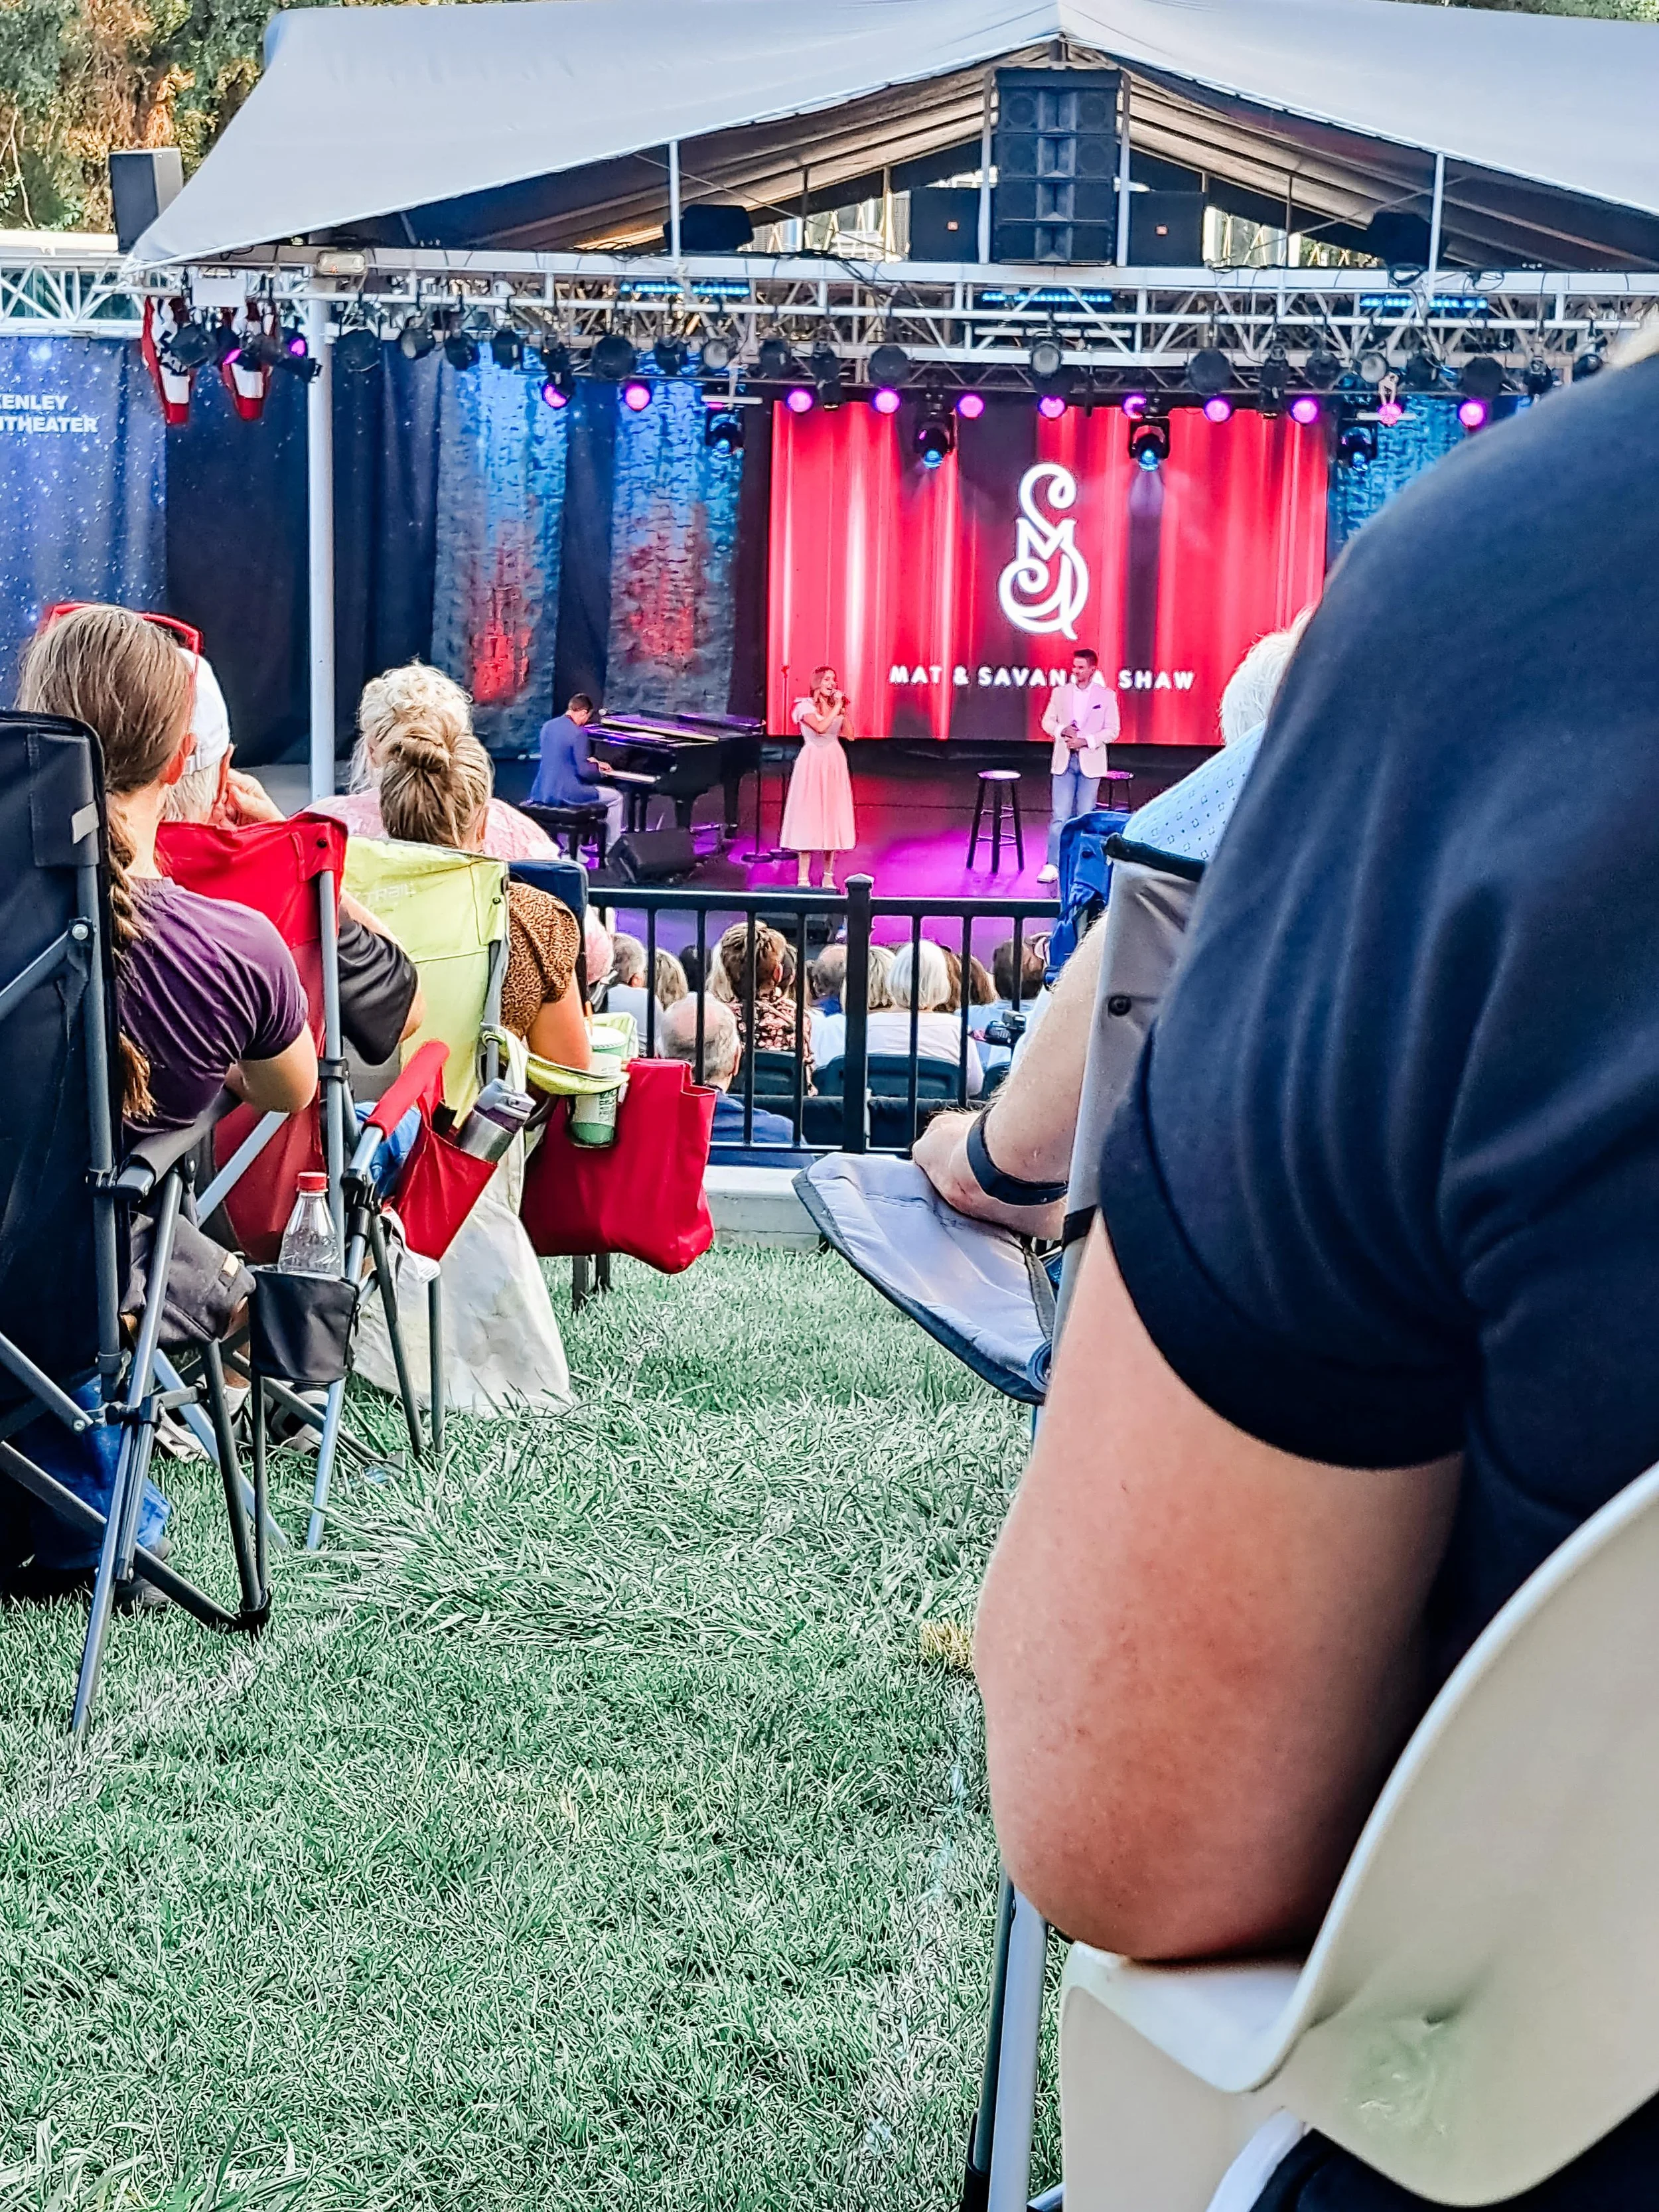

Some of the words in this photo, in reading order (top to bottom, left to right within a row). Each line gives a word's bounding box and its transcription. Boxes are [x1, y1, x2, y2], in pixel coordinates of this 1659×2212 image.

[0, 394, 69, 411] ENLEY
[889, 665, 942, 684] MAT
[953, 665, 970, 685] &
[1118, 669, 1194, 690] SHAW
